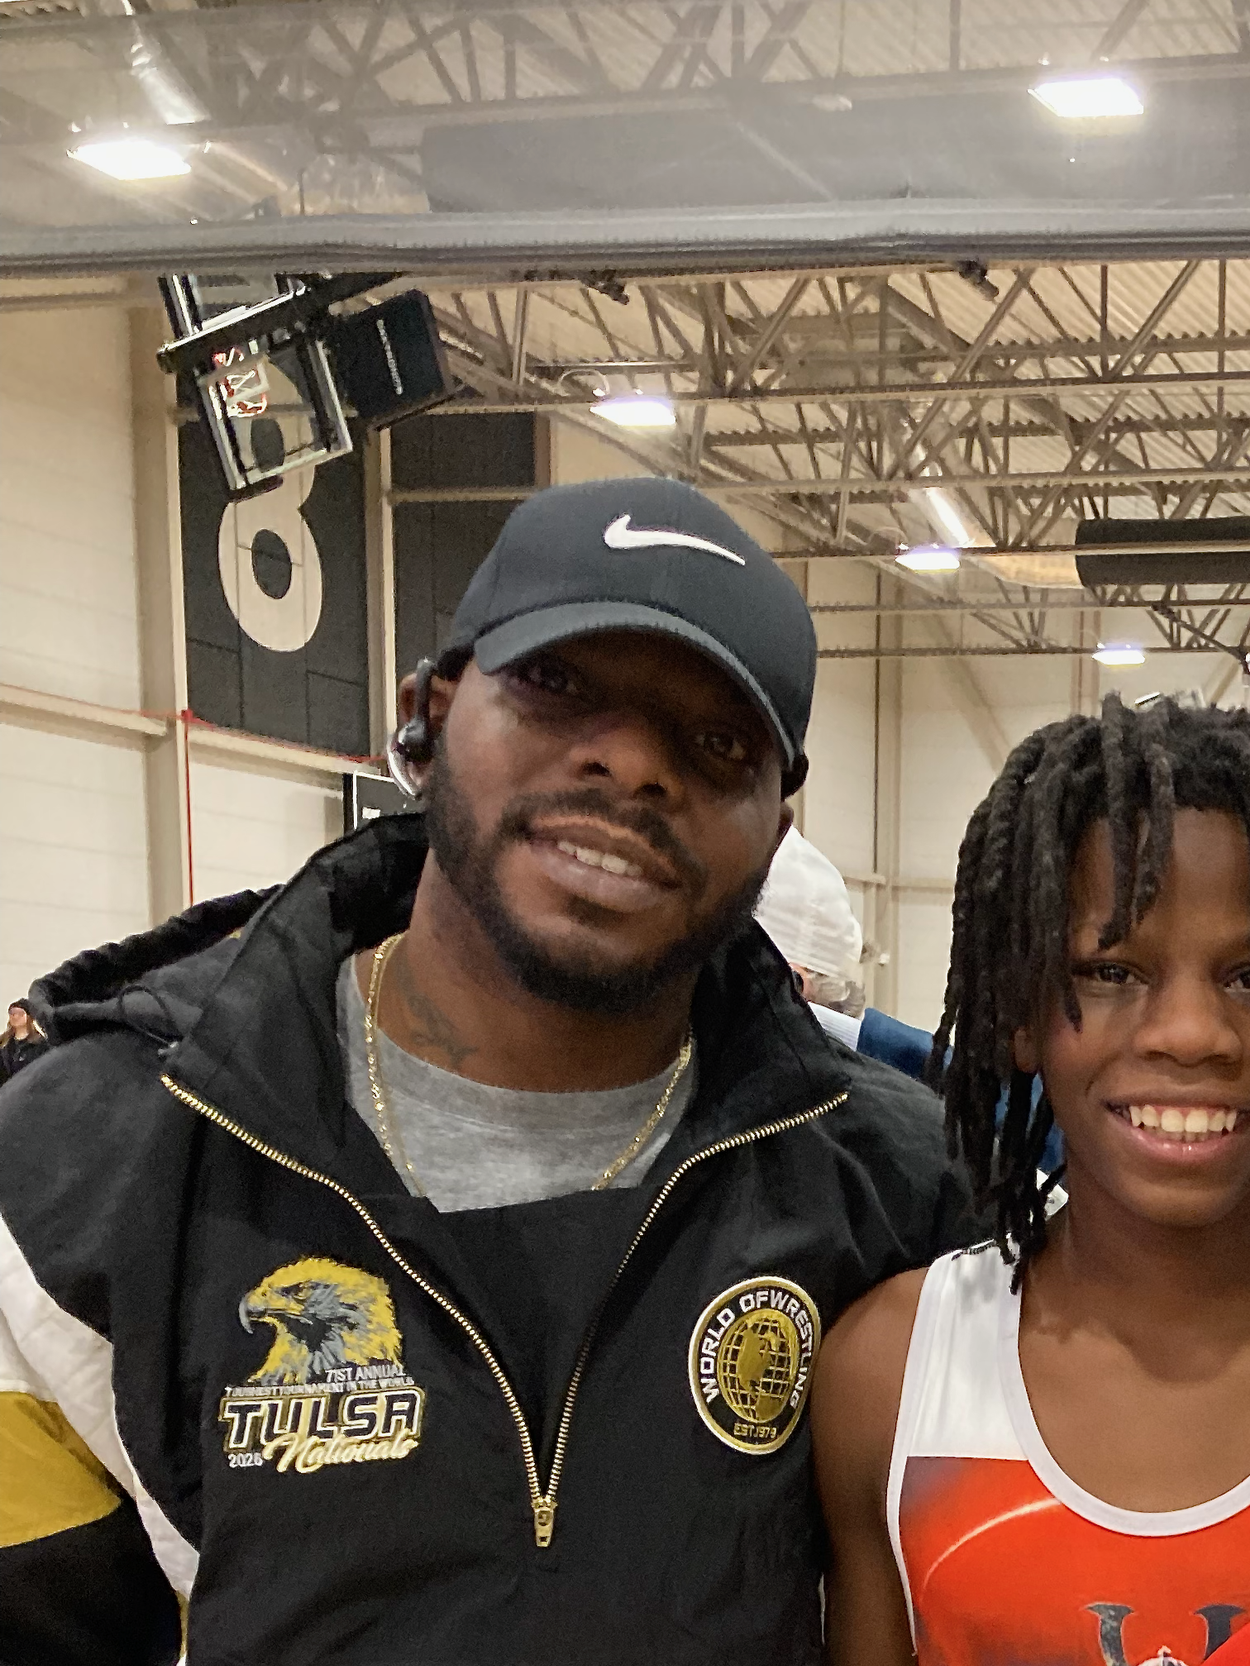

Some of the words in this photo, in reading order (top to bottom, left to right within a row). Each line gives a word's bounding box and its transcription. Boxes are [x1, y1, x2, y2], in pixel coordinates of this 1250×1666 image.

[325, 1367, 352, 1383] 71ST
[354, 1364, 406, 1381] ANNUAL
[700, 1308, 735, 1403] WORLD
[739, 1290, 769, 1312] OF
[770, 1289, 813, 1408] WRESTLING
[222, 1388, 422, 1449] TULSA
[262, 1429, 419, 1473] Nationals
